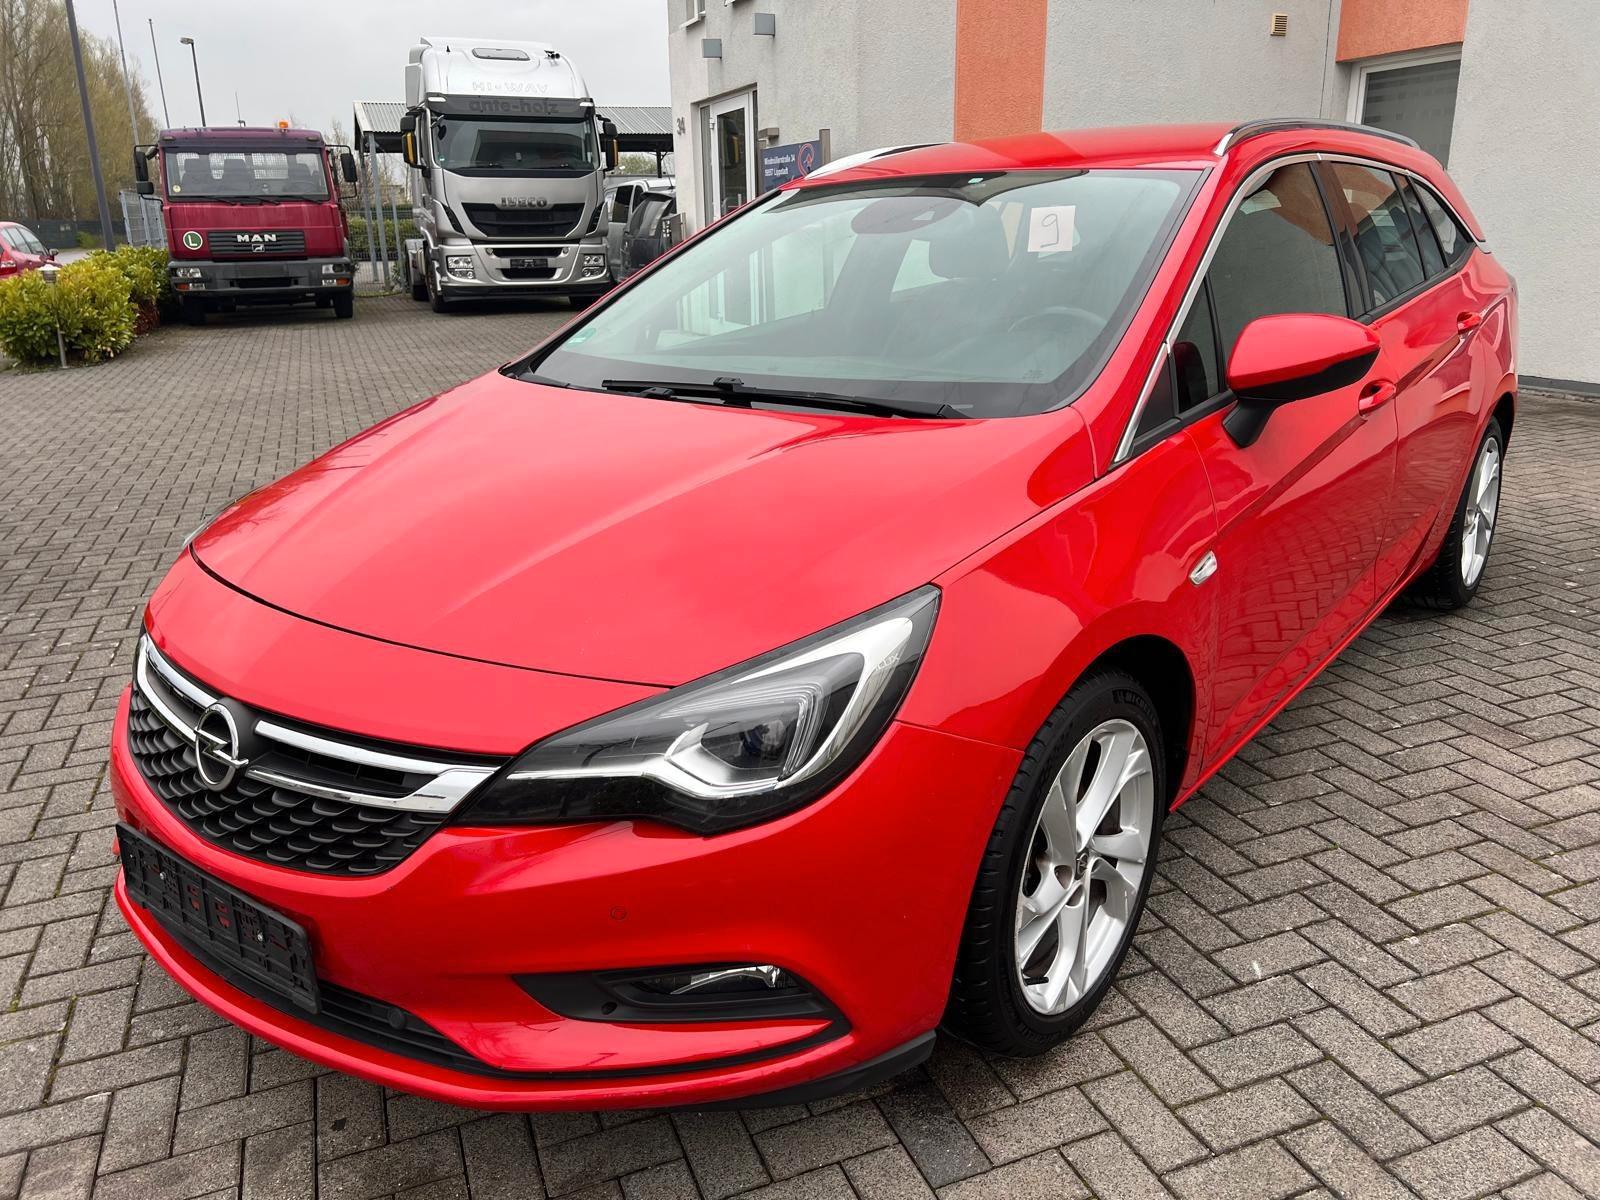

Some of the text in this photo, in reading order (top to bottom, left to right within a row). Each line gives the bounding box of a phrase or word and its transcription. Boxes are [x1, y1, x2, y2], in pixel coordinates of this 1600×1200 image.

[676, 116, 686, 136] 34
[500, 197, 548, 208] IVECO
[1040, 213, 1060, 248] 9
[188, 234, 198, 246] L
[236, 234, 277, 242] MAN
